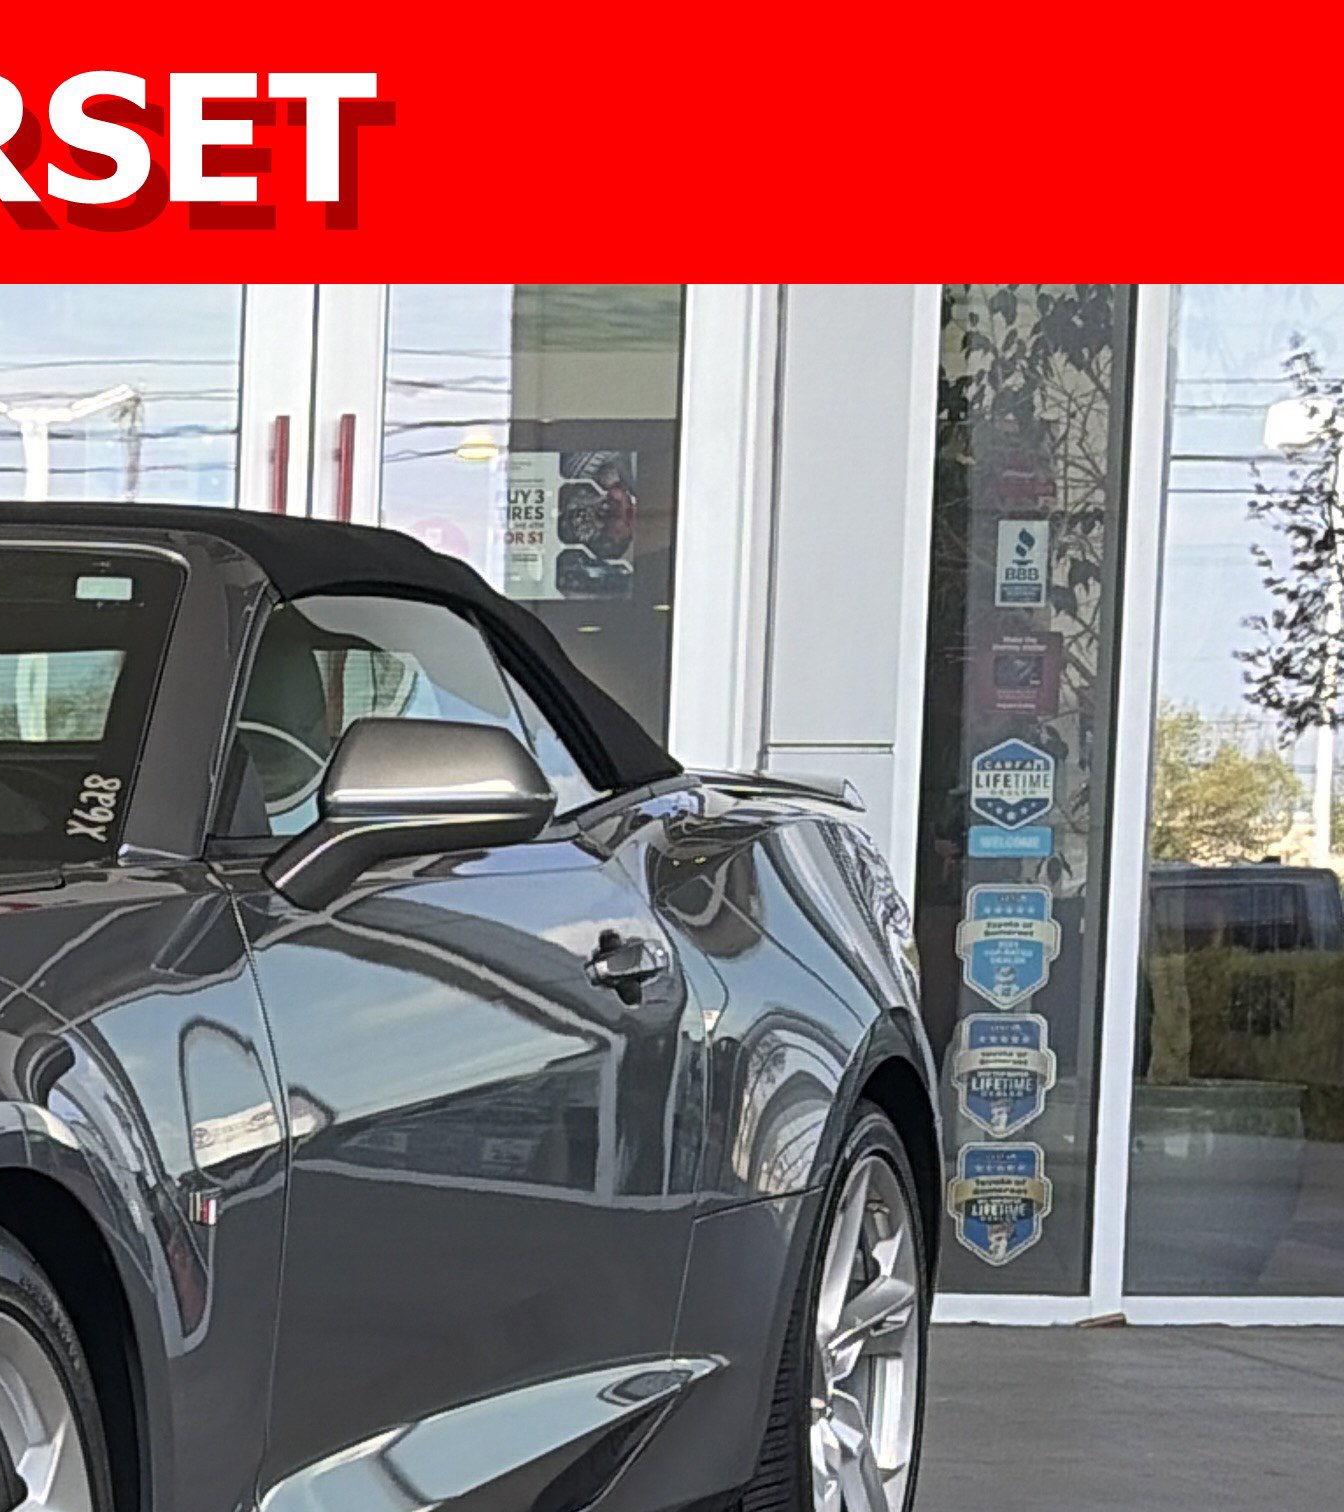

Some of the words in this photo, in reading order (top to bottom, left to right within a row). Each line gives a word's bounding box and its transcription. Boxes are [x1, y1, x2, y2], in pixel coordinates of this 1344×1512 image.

[534, 489, 545, 503] 3
[1005, 568, 1039, 581] BBB
[975, 773, 1050, 788] LIFETIME
[972, 1077, 1033, 1091] LIFETIME
